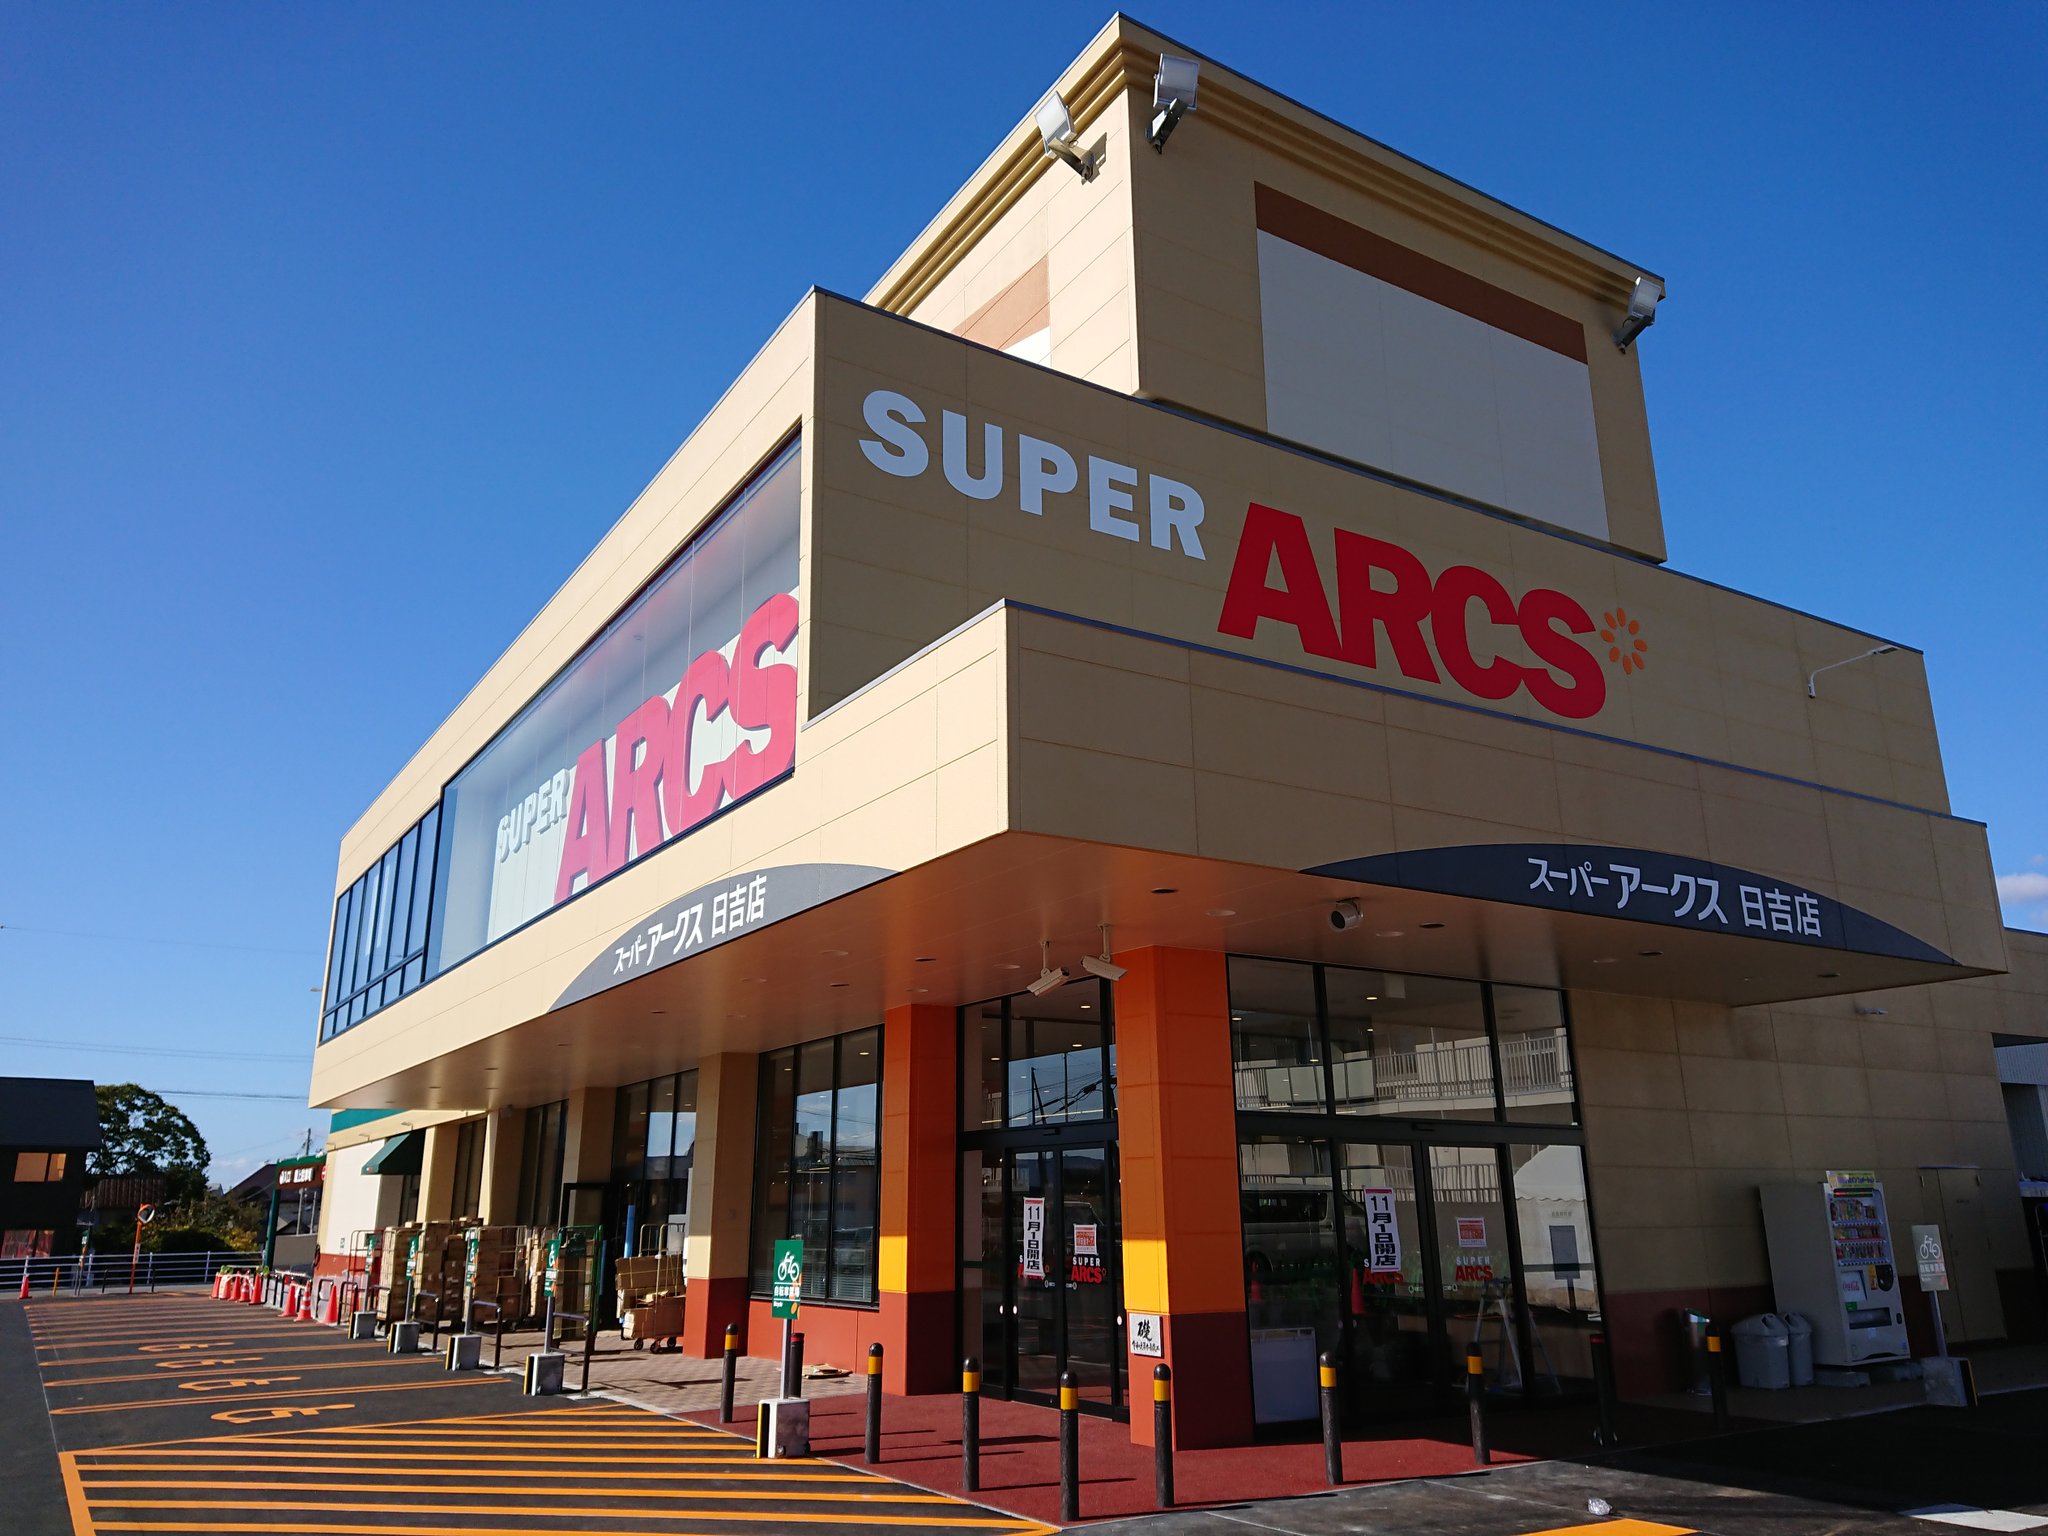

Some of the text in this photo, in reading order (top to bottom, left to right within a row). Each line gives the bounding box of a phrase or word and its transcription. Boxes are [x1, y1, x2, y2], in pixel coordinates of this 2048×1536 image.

[858, 390, 1607, 719] SUPER ARCS
[497, 593, 799, 907] SUPER ARCS
[711, 874, 767, 938] 日吉店
[1528, 857, 1822, 937] スーパーアークス 日吉店
[1071, 1266, 1103, 1284] ARCS
[1072, 1256, 1101, 1267] SUPER
[1455, 1265, 1493, 1281] ARCS
[1456, 1255, 1491, 1266] SUPER
